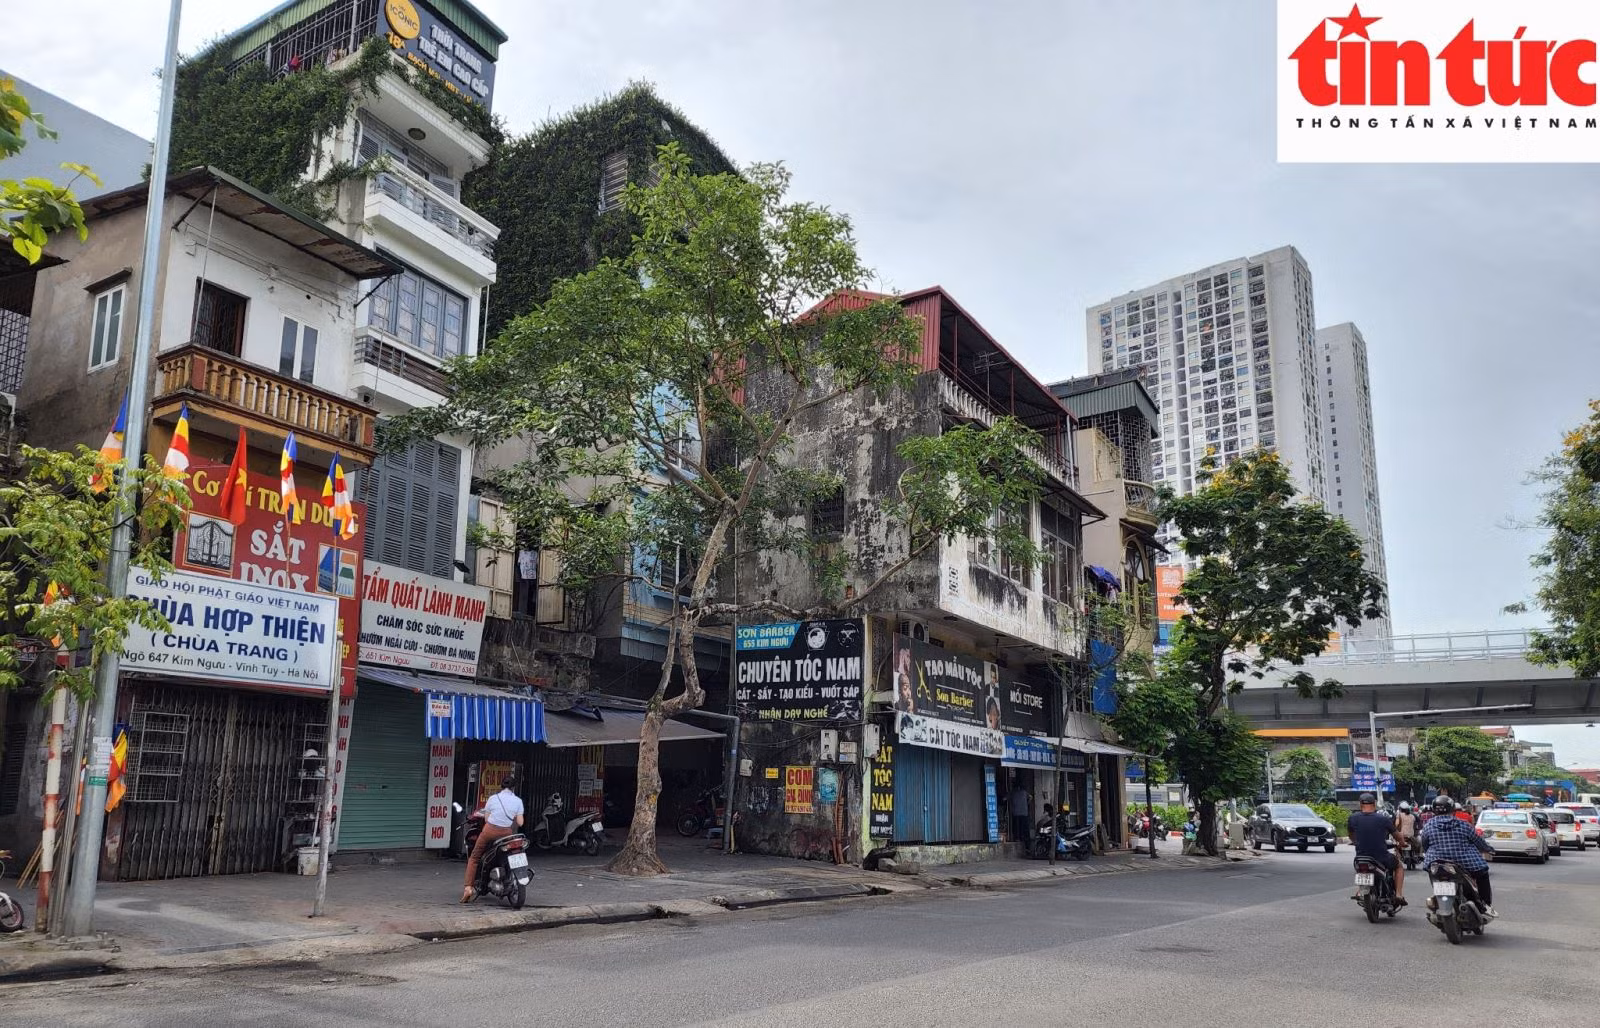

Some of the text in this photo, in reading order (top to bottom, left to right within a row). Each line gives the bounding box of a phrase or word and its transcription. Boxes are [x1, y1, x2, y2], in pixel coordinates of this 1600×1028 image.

[437, 50, 453, 71] EM
[453, 63, 471, 86] CAO
[454, 42, 482, 74] TRANG
[192, 471, 221, 497] Cơ
[251, 520, 306, 564] SẮT
[173, 581, 194, 594] HỘI
[199, 585, 230, 599] PHẬT
[234, 589, 263, 603] GIÁO
[268, 595, 291, 607] VIỆT
[294, 601, 319, 613] NAM
[392, 576, 423, 611] QUẤT
[423, 585, 452, 617] LÀNH
[454, 595, 486, 626] MẠNH
[203, 606, 254, 637] HỢP
[261, 614, 325, 646] THIỆN
[738, 626, 795, 638] SƠN BARBER
[163, 631, 220, 653] CHÙA
[226, 642, 288, 661] TRANG
[743, 639, 755, 648] 655
[757, 638, 769, 647] KIM
[148, 652, 169, 663] 647
[172, 654, 193, 666] Kim
[197, 658, 225, 670] Ngưu
[236, 662, 258, 672] Vĩnh
[261, 664, 278, 677] Tuy
[303, 670, 318, 680] Nội
[365, 652, 377, 660] 651
[380, 653, 391, 662] Kim
[738, 653, 860, 683] CHUYÊN TÓC NAM
[925, 656, 983, 690] TẠO MẪU TÓC
[757, 685, 772, 700] SẤY
[779, 688, 793, 701] TẠO
[821, 683, 841, 698] VUỐT
[843, 684, 859, 698] SÁP
[950, 693, 975, 708] Barber
[1023, 692, 1043, 709] STORE
[759, 704, 829, 722] NHẬN DẠY NGHỀ
[929, 726, 979, 752] CẮT TÓC NAM
[432, 745, 453, 760] MẠNH
[434, 765, 448, 780] CẠO
[434, 784, 446, 798] GIÓ
[872, 792, 893, 811] NAM
[430, 803, 447, 818] GIÁC
